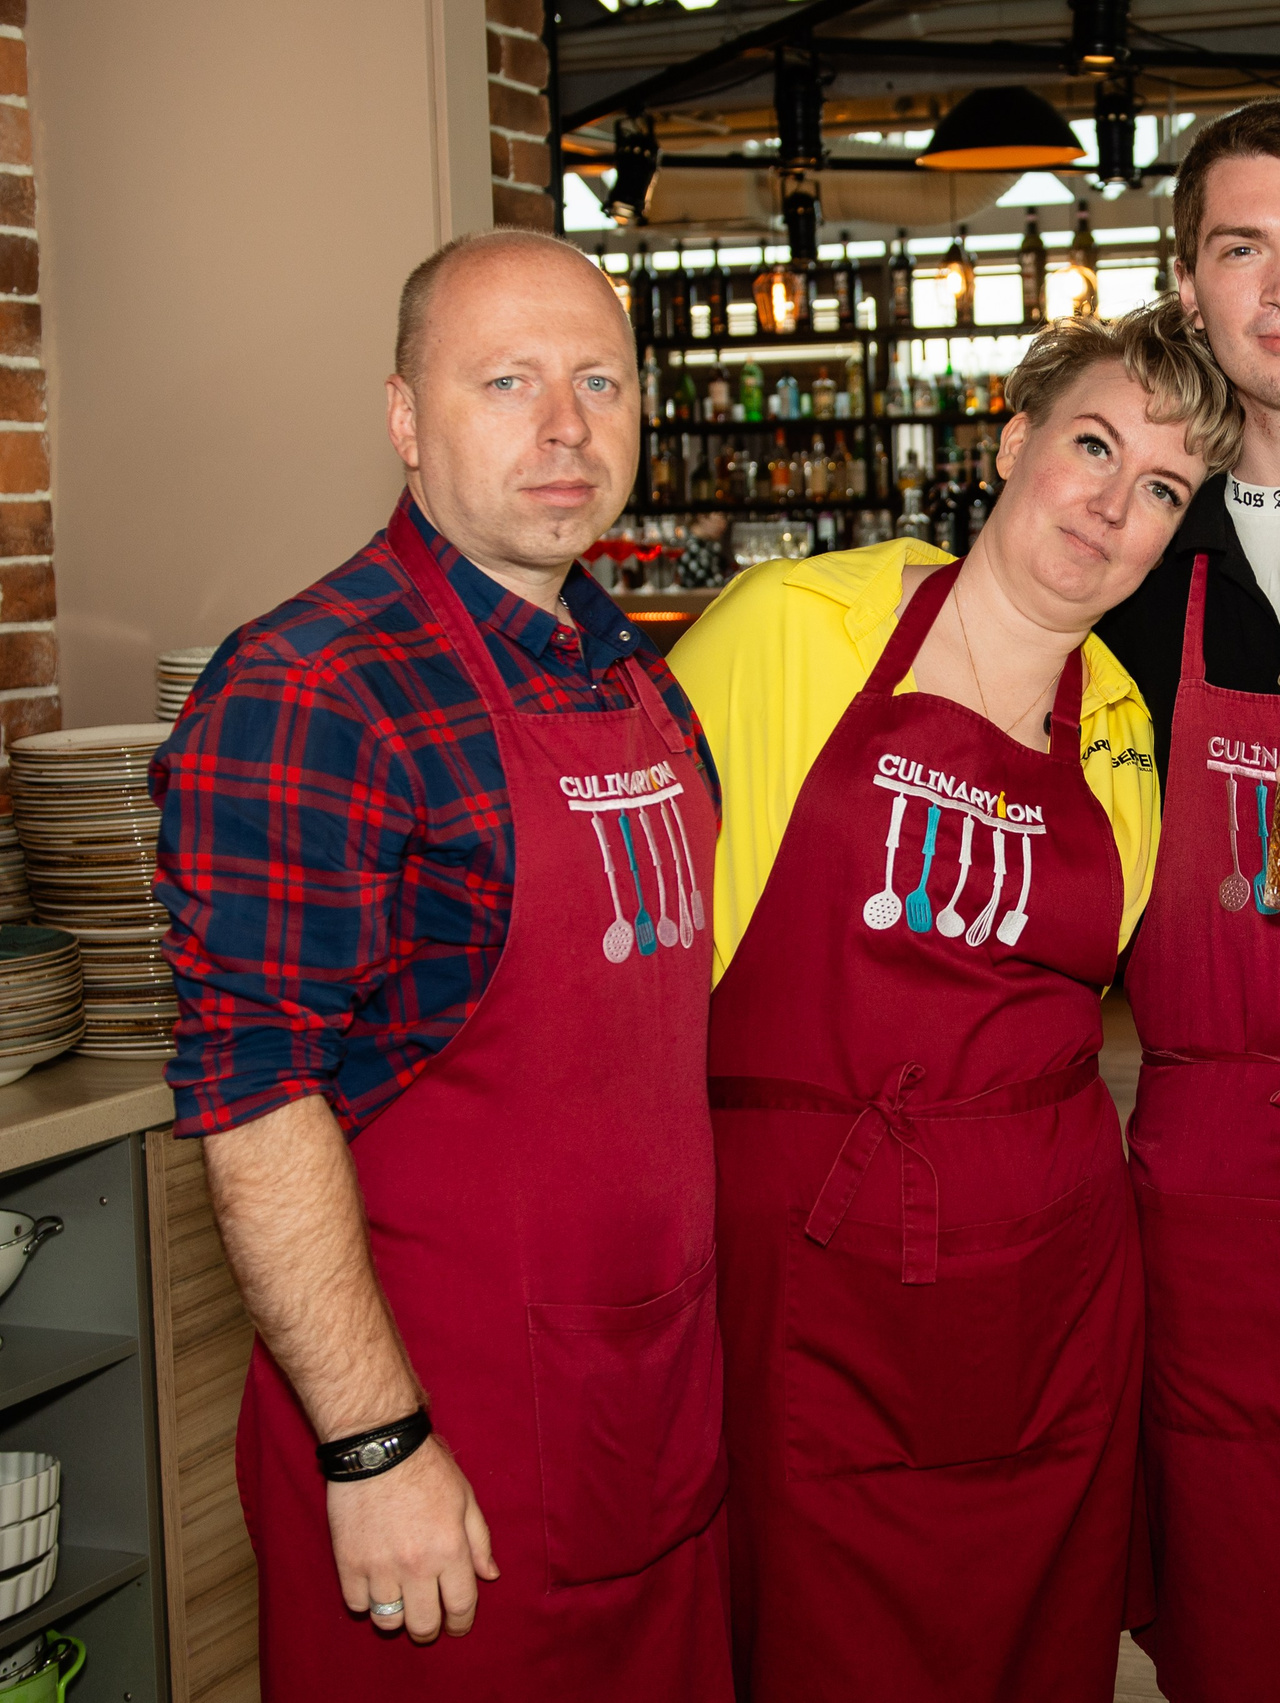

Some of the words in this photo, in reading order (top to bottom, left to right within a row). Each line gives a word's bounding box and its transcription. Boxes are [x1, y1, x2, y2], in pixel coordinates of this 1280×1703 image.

[1231, 480, 1265, 508] Los
[1207, 736, 1278, 769] CULIN
[559, 760, 677, 799] CULINARYON
[878, 753, 1044, 823] CULINARYON
